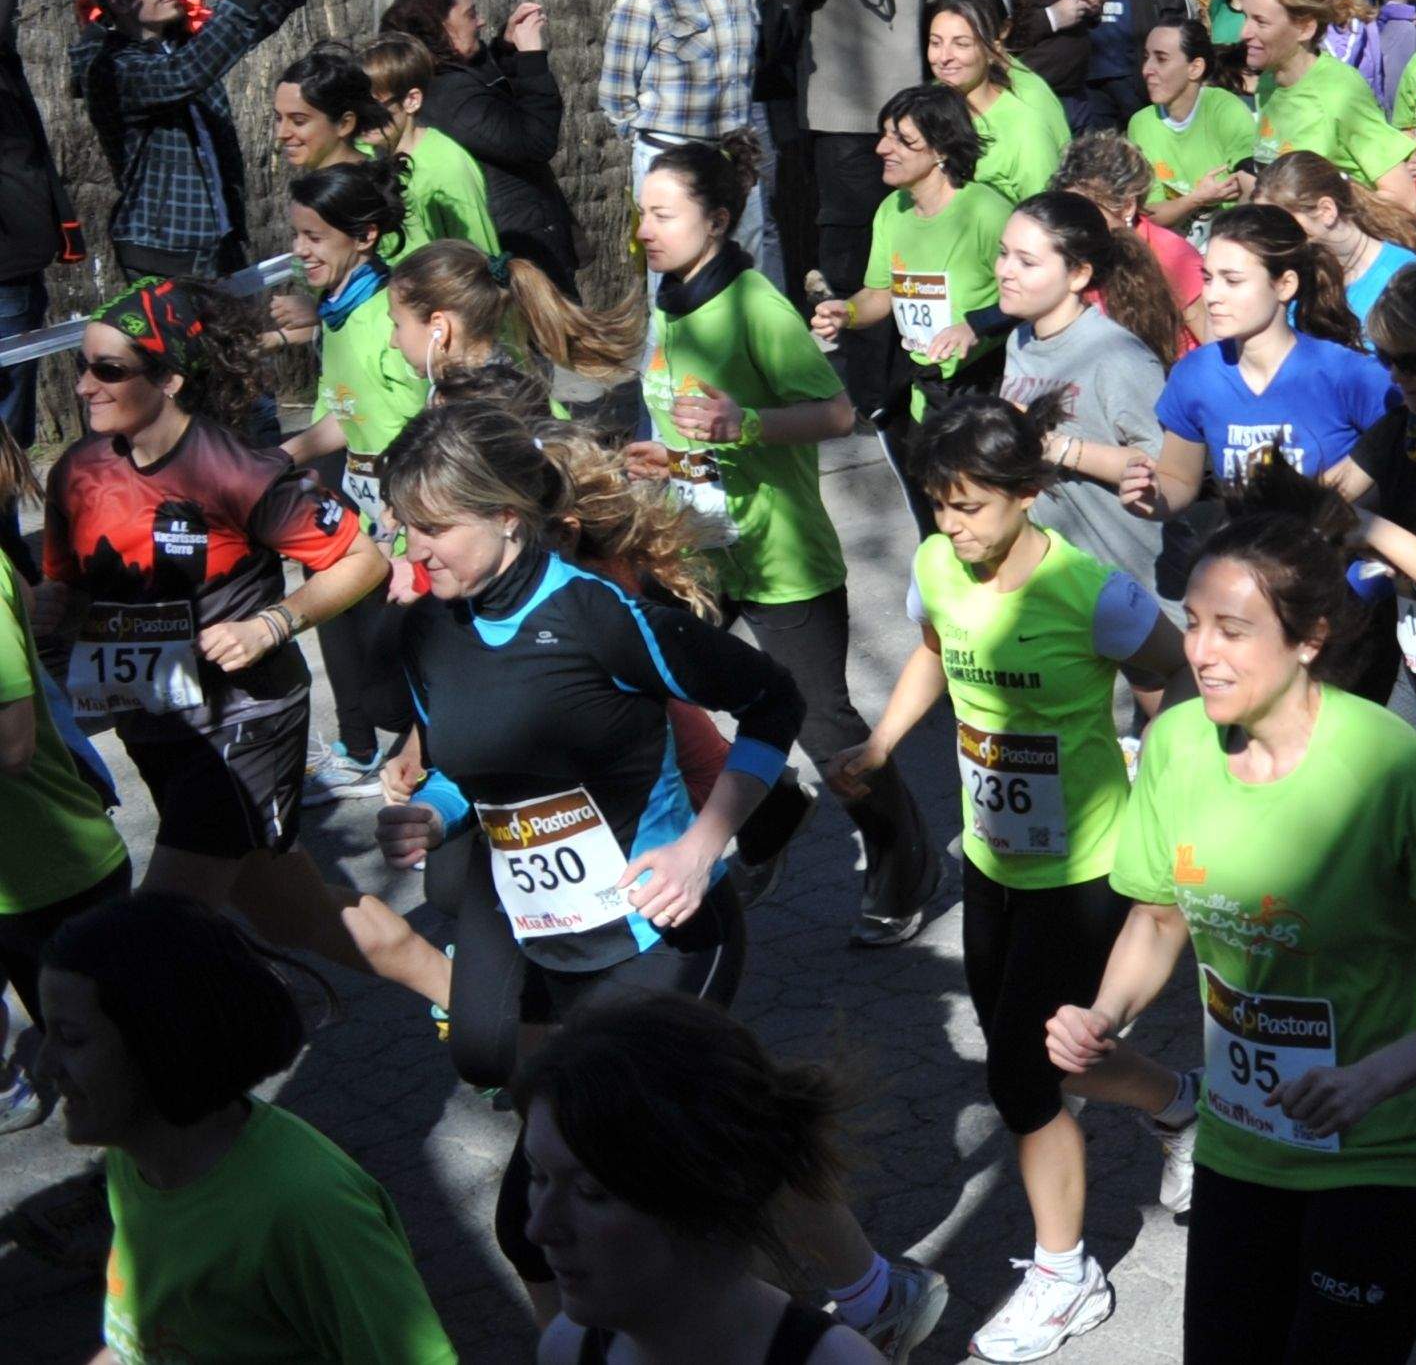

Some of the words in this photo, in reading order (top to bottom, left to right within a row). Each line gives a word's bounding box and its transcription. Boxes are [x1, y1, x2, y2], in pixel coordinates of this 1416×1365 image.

[899, 303, 932, 327] 128
[165, 543, 194, 555] Corre
[134, 618, 190, 634] Pastora
[90, 647, 163, 684] 157
[999, 745, 1056, 766] Pastora
[971, 769, 1033, 816] 236
[529, 805, 596, 837] Pastora
[507, 845, 587, 894] 530
[1257, 1011, 1328, 1037] Pastora
[1229, 1040, 1280, 1094] 95
[1312, 1271, 1360, 1301] CIRSA
